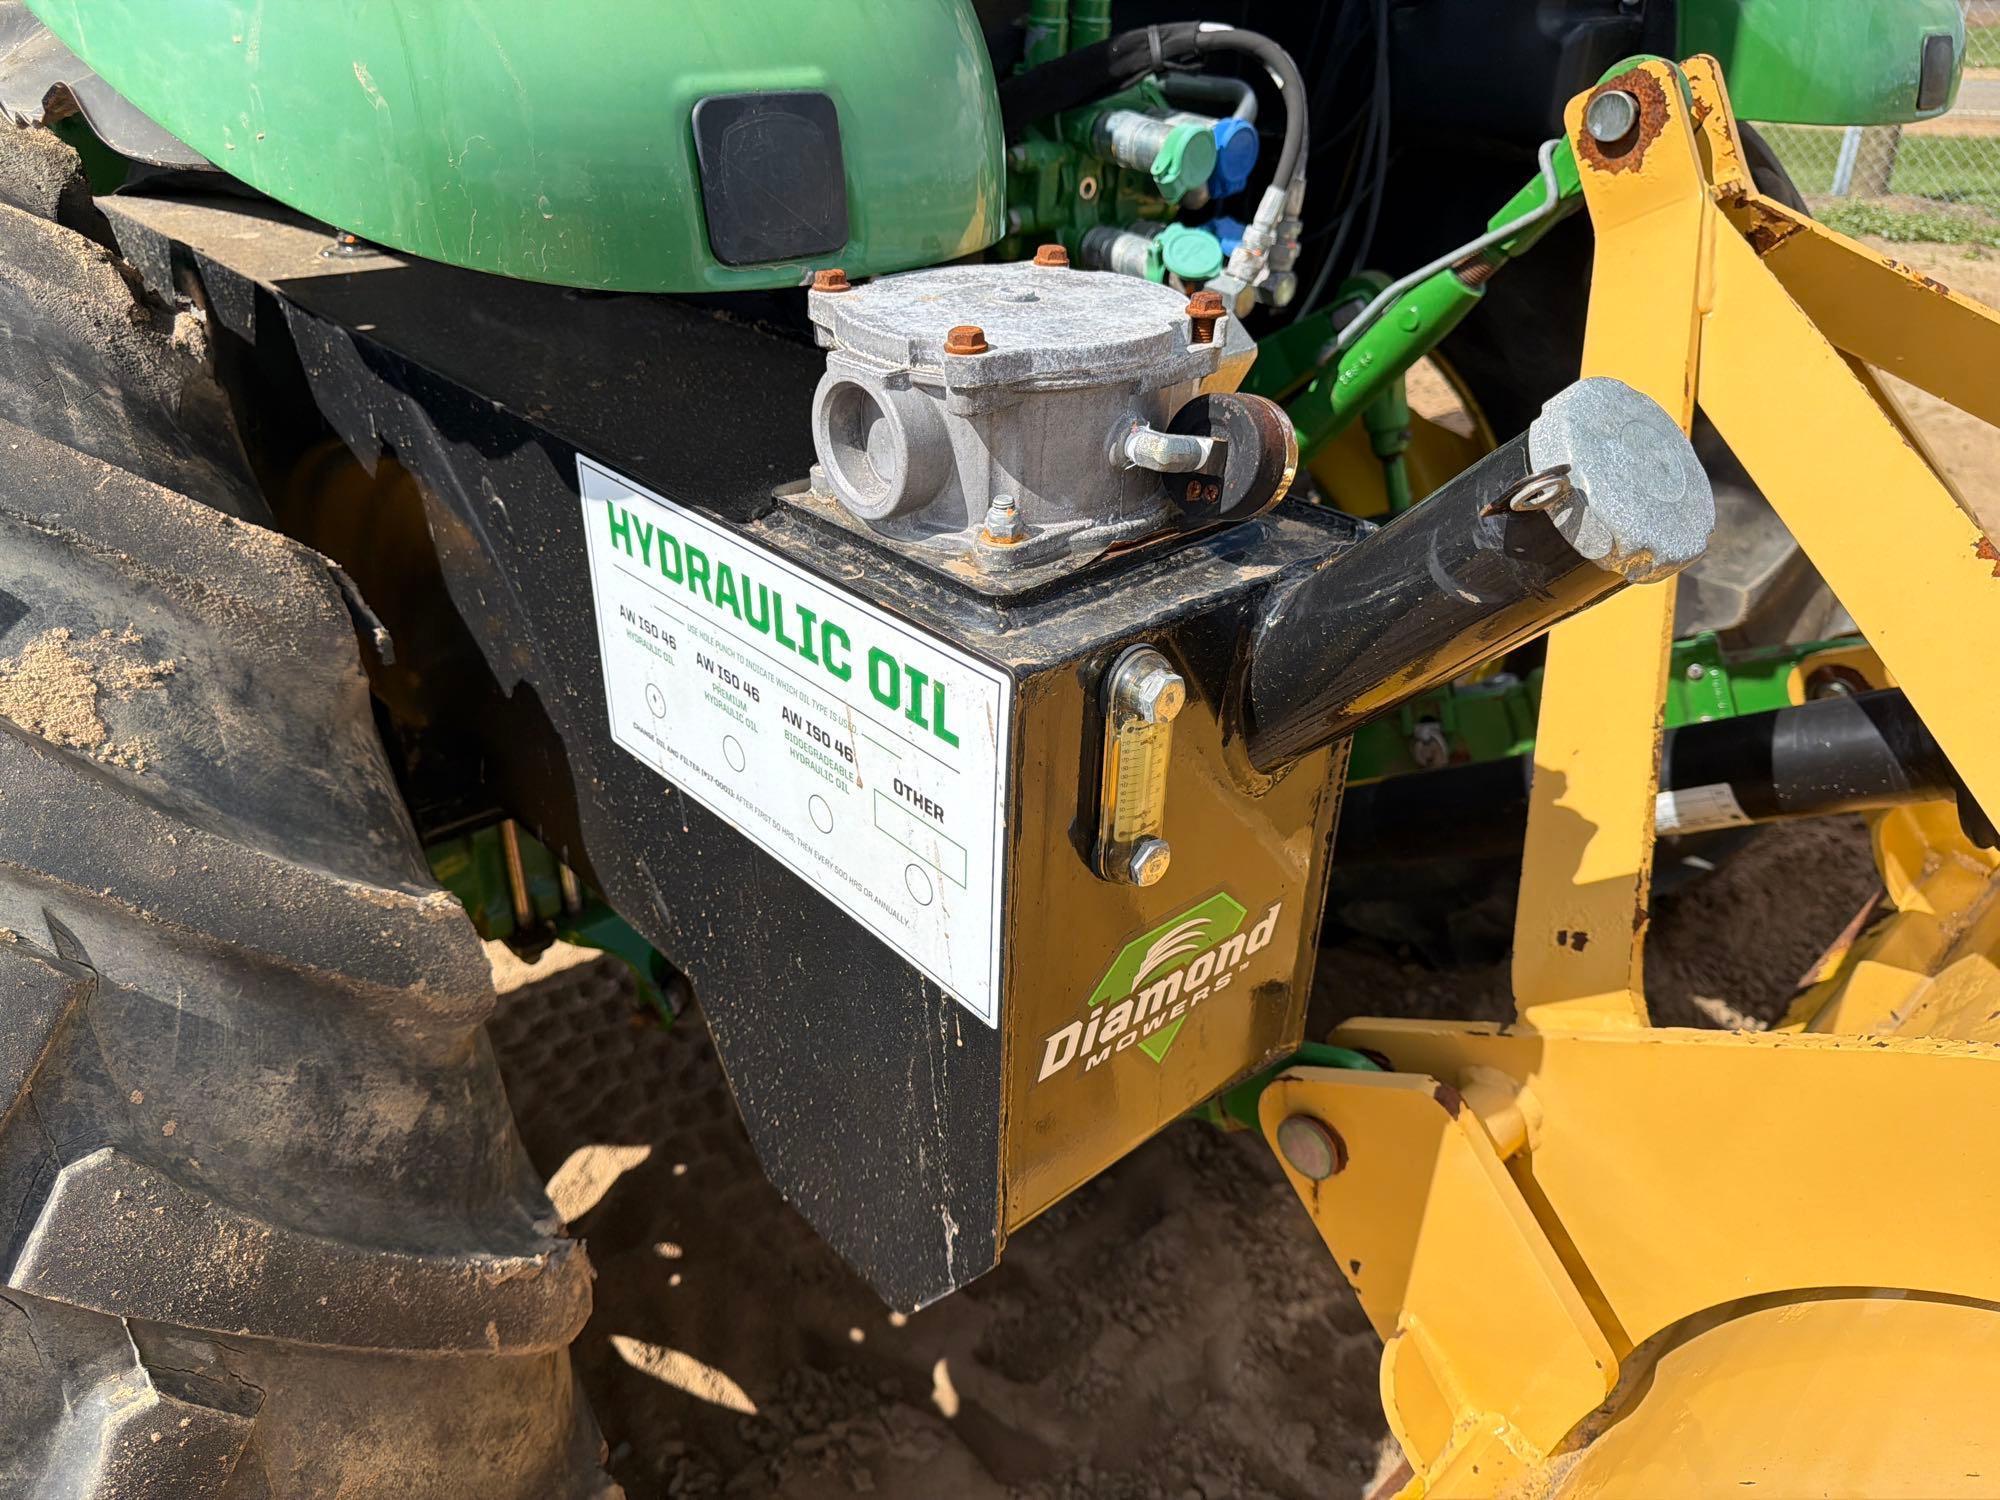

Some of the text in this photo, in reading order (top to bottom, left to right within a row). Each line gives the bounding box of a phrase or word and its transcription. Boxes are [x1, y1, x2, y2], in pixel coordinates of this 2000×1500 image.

[606, 500, 960, 749] HYDRAULIC OIL
[620, 604, 677, 650] AW ISO 46
[626, 628, 675, 666] HYDRAULIC OIL
[687, 623, 697, 637] USE
[699, 631, 713, 646] HOLE
[715, 639, 735, 658] PUNCH
[737, 653, 744, 664] TO
[745, 658, 774, 683] INDICATE
[776, 677, 798, 697] WHICH
[799, 691, 810, 706] OIL
[812, 699, 828, 717] TYPE
[829, 710, 837, 722] IS
[697, 652, 760, 703] AW ISO 46
[712, 683, 747, 712] PREMIUM
[704, 691, 758, 734] HYDRAULIC OIL
[782, 705, 854, 763] AW ISO 46
[784, 729, 854, 783] BIODEGRADEABLE
[789, 747, 850, 795] HYDRAULIC OIL
[893, 777, 945, 824] OTHER
[680, 754, 700, 774] FILTER
[735, 795, 753, 812] AFTER
[754, 806, 772, 824] FIRST
[772, 819, 781, 832] 50
[797, 836, 813, 854] THEN
[814, 849, 834, 870] EVERY
[835, 866, 848, 881] 500
[849, 876, 863, 893] HRS
[863, 887, 873, 900] OR
[1038, 901, 1282, 1083] Diamond
[1085, 976, 1232, 1072] MOWERS
